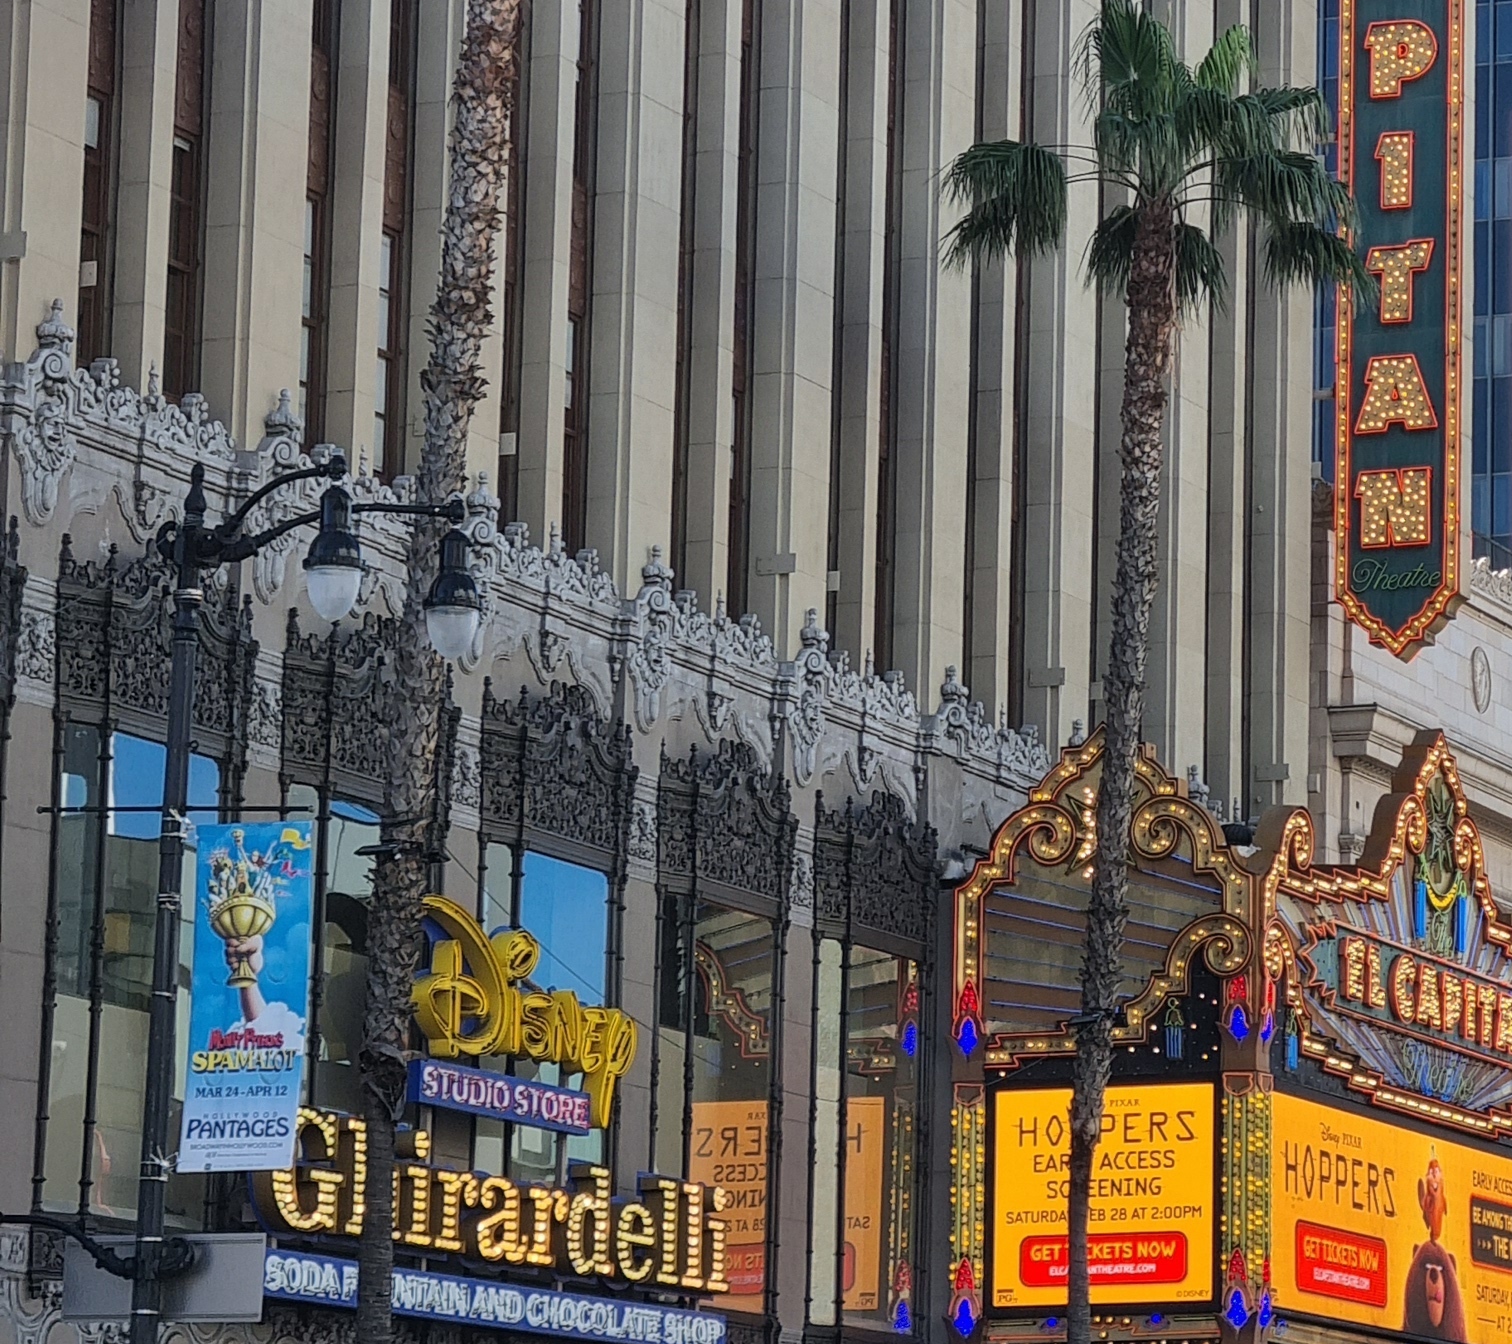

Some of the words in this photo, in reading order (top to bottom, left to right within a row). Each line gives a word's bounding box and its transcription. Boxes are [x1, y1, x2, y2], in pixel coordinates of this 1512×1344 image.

[1351, 557, 1441, 593] Theatre
[1342, 935, 1386, 1009] EL
[414, 894, 637, 1129] Disney
[191, 1050, 297, 1074] SPAMALOT
[195, 1087, 223, 1099] MAR
[275, 1085, 288, 1096] 12
[422, 1065, 512, 1110] STUDIO
[513, 1083, 591, 1129] STORE
[1110, 1099, 1140, 1107] PIXAR
[203, 1111, 278, 1120] HOLLYWOOD
[186, 1117, 289, 1139] PANTAGES
[1015, 1111, 1197, 1147] HOPERS
[1342, 1132, 1363, 1149] PIXAR
[1033, 1154, 1073, 1173] EAR
[1099, 1150, 1175, 1170] ACCESS
[1046, 1177, 1162, 1199] SCEENING
[1284, 1140, 1396, 1218] HOPPERS
[1472, 1170, 1492, 1191] EARLY
[1006, 1210, 1068, 1225] SATURDA
[1089, 1208, 1106, 1221] EB
[1110, 1208, 1127, 1221] 28
[1132, 1207, 1148, 1220] AT
[1151, 1205, 1202, 1219] 2:00PM
[1472, 1207, 1481, 1225] BE
[1482, 1209, 1504, 1229] AMONG
[1030, 1244, 1062, 1261] GET
[1137, 1240, 1176, 1258] NOW
[1304, 1236, 1322, 1261] GET
[1323, 1239, 1358, 1269] TICKETS
[1359, 1248, 1379, 1272] NOW
[1493, 1235, 1509, 1259] THE
[263, 1255, 341, 1299] SODA
[343, 1264, 471, 1318] FNTAIN
[471, 1284, 526, 1328] AND
[527, 1293, 664, 1344] CHOCOLATE
[1183, 1289, 1209, 1298] DISNEY
[1496, 1316, 1506, 1331] AT
